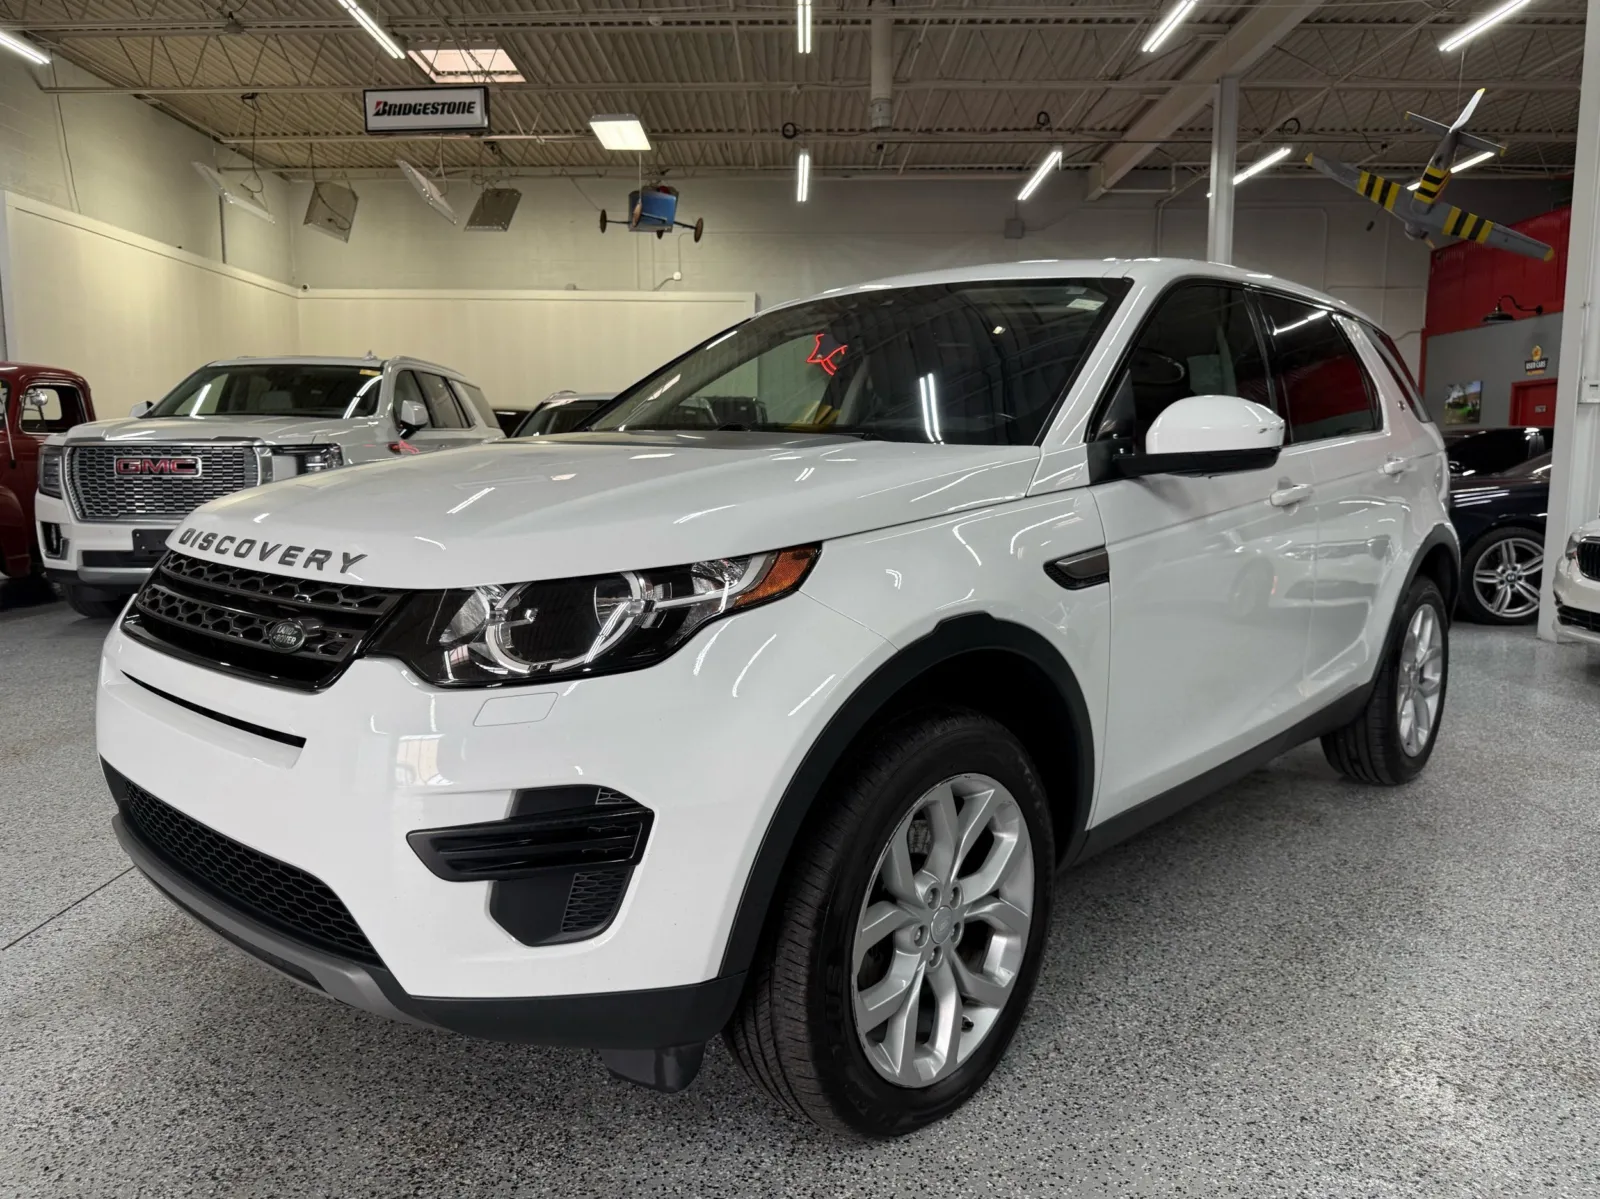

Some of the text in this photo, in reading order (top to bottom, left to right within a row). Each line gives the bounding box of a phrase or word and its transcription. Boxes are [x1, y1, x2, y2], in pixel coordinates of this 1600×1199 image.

[372, 100, 476, 116] BRIDGESTONE
[116, 459, 197, 474] GMC
[178, 528, 369, 574] DISCOVERY
